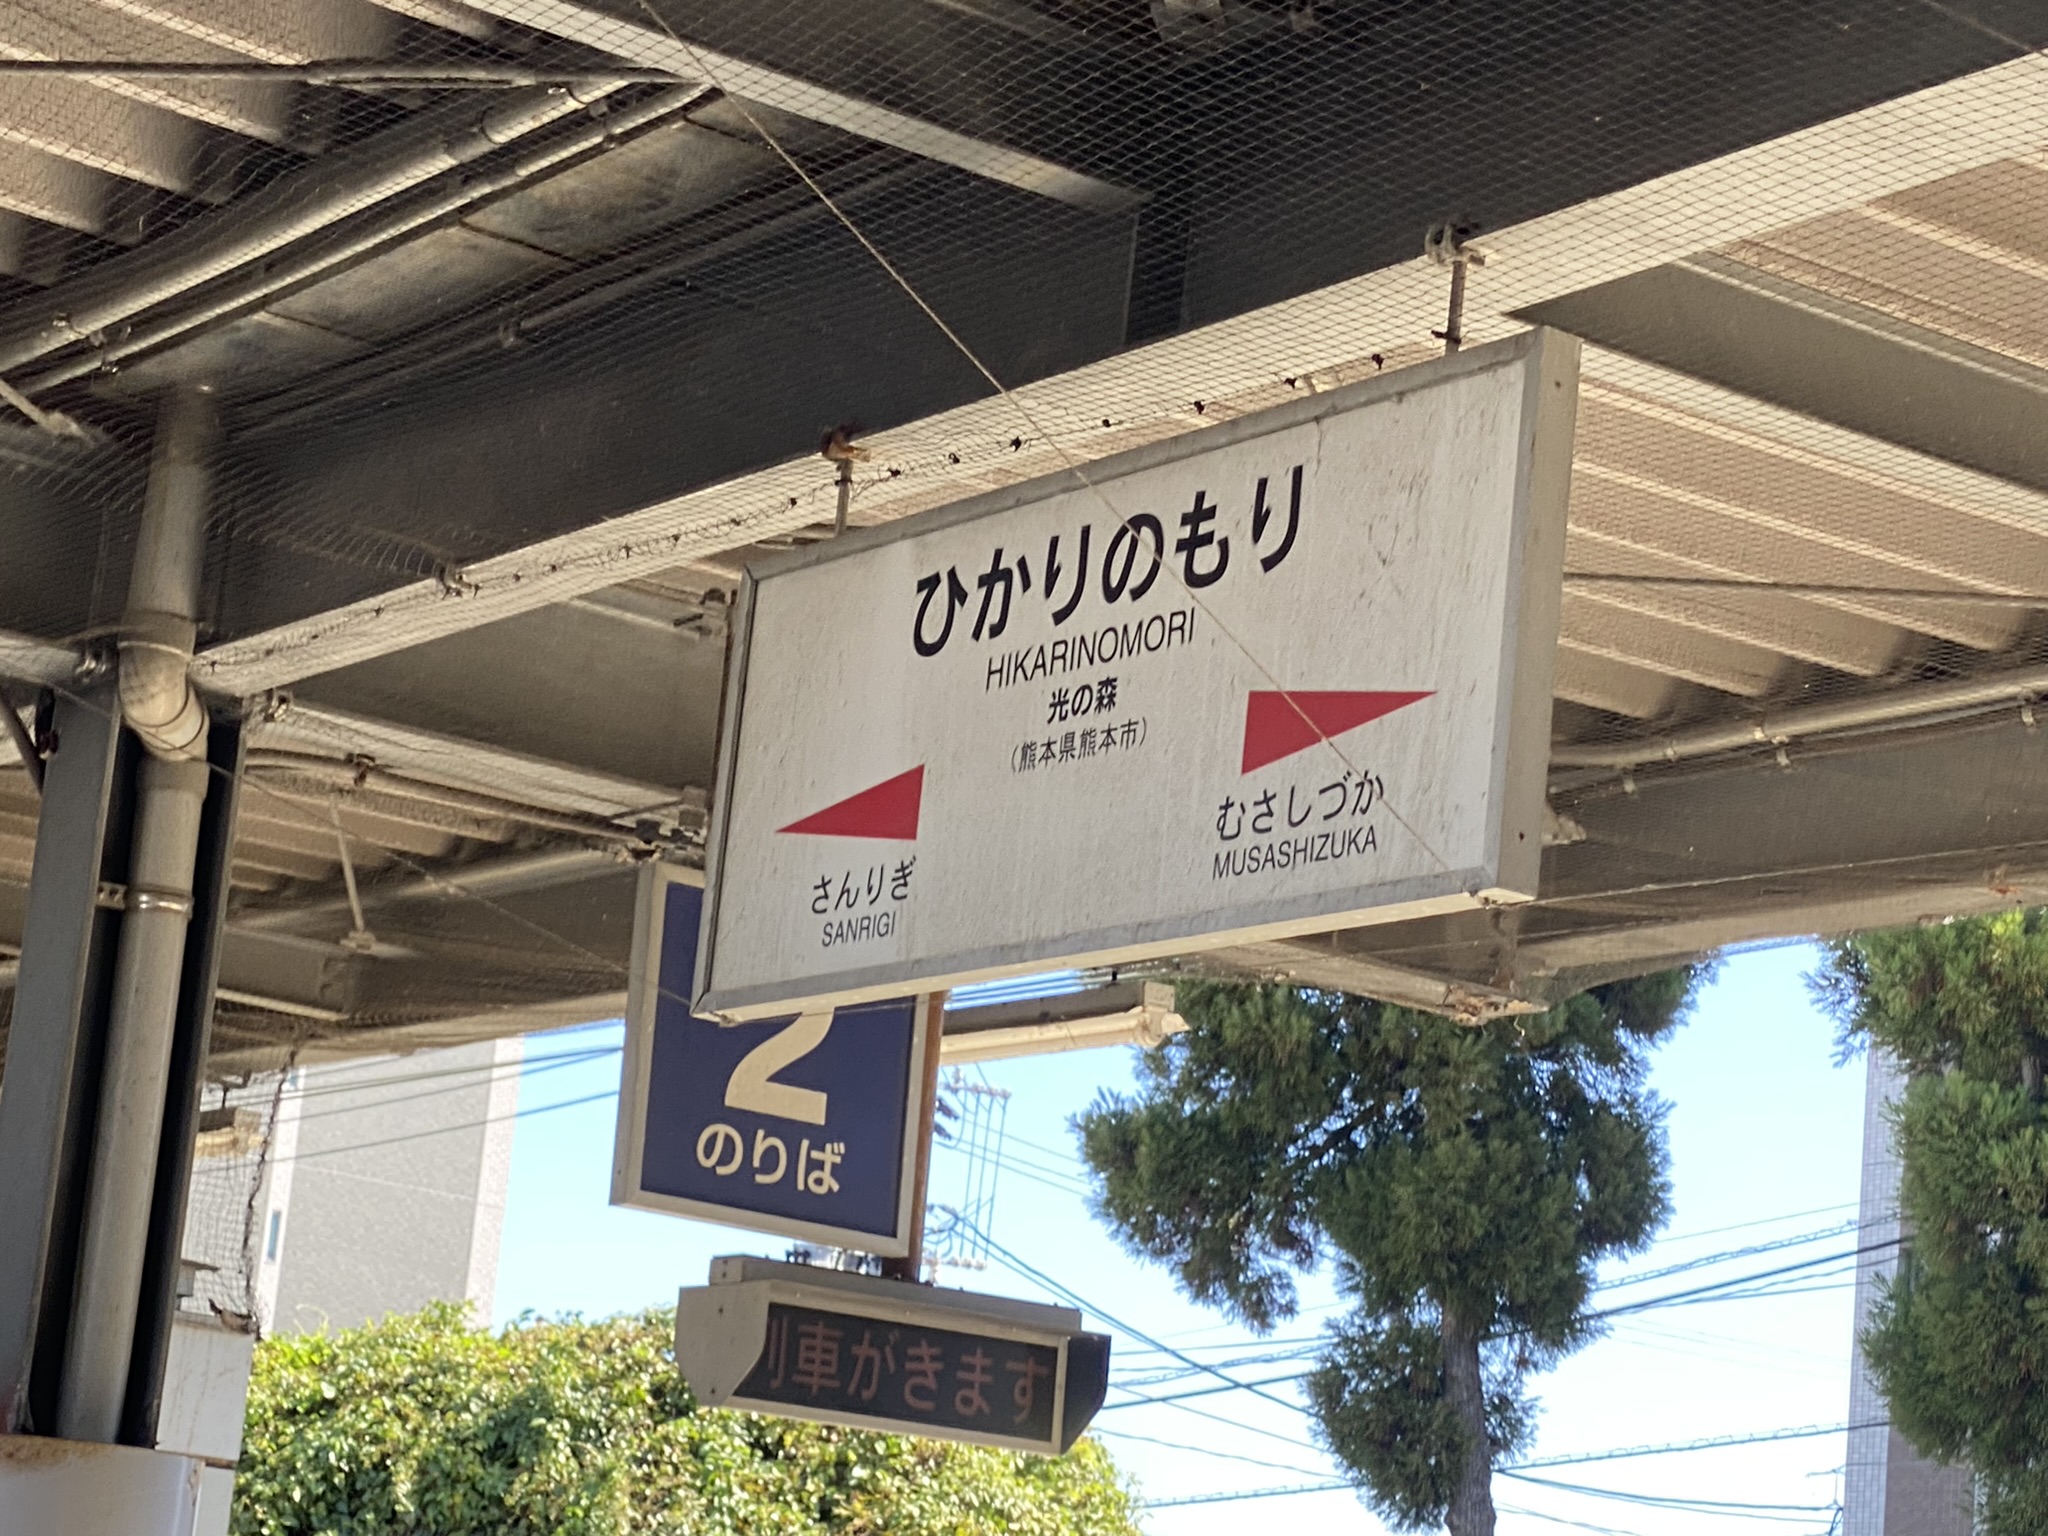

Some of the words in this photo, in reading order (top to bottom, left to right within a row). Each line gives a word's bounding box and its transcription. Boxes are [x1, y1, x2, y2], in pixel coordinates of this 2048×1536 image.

[914, 465, 1303, 657] ひかりのもり
[986, 607, 1195, 691] HIKARINOMORI
[1047, 676, 1118, 724] 光の森
[1011, 716, 1147, 773] （熊本県熊本市）
[1217, 769, 1384, 842] むさしづか
[1213, 825, 1377, 880] MUSASHIZUKA
[811, 856, 916, 914] さんりぎ
[822, 911, 896, 947] SANRIGI
[696, 1123, 846, 1195] のりば
